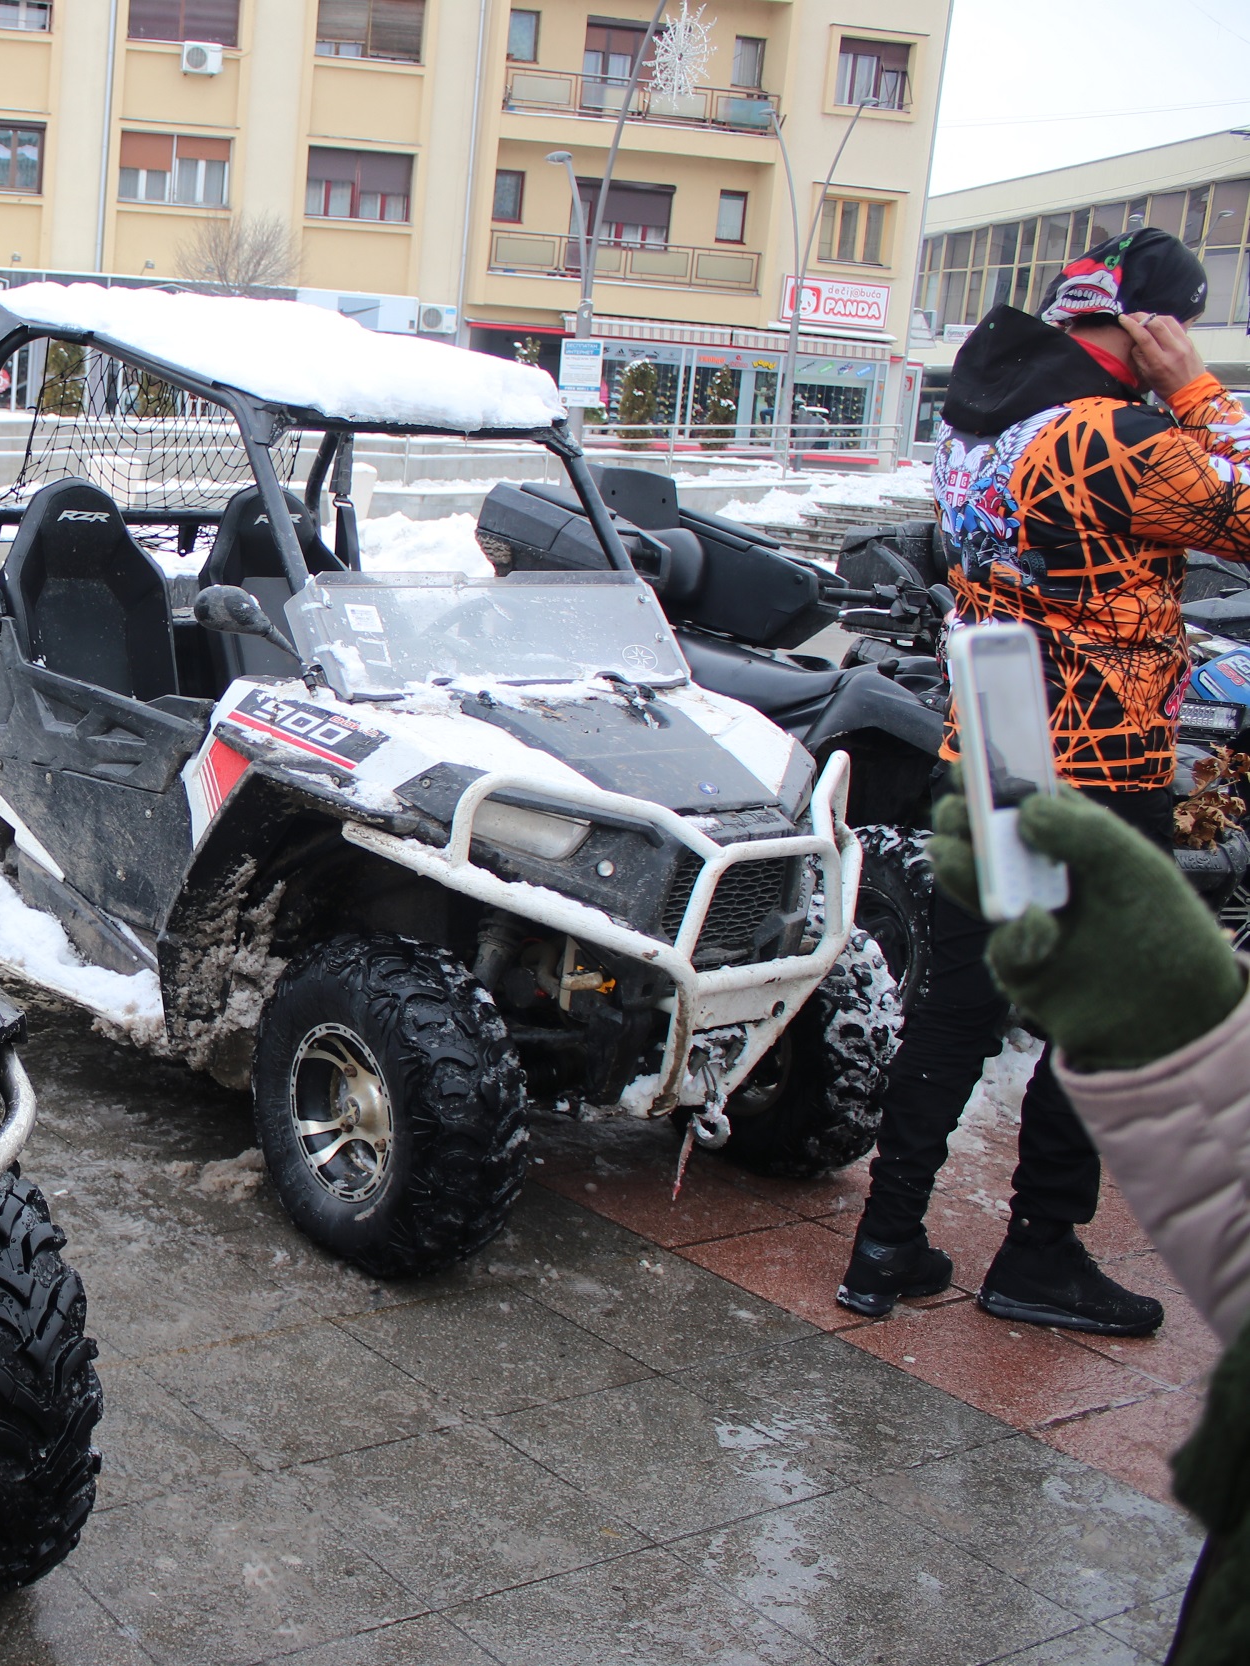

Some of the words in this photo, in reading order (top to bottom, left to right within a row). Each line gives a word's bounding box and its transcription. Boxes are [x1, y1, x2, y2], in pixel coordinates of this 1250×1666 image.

[824, 298, 882, 320] PANDA
[57, 509, 111, 523] RZR
[254, 513, 302, 526] RR
[252, 699, 353, 746] 900
